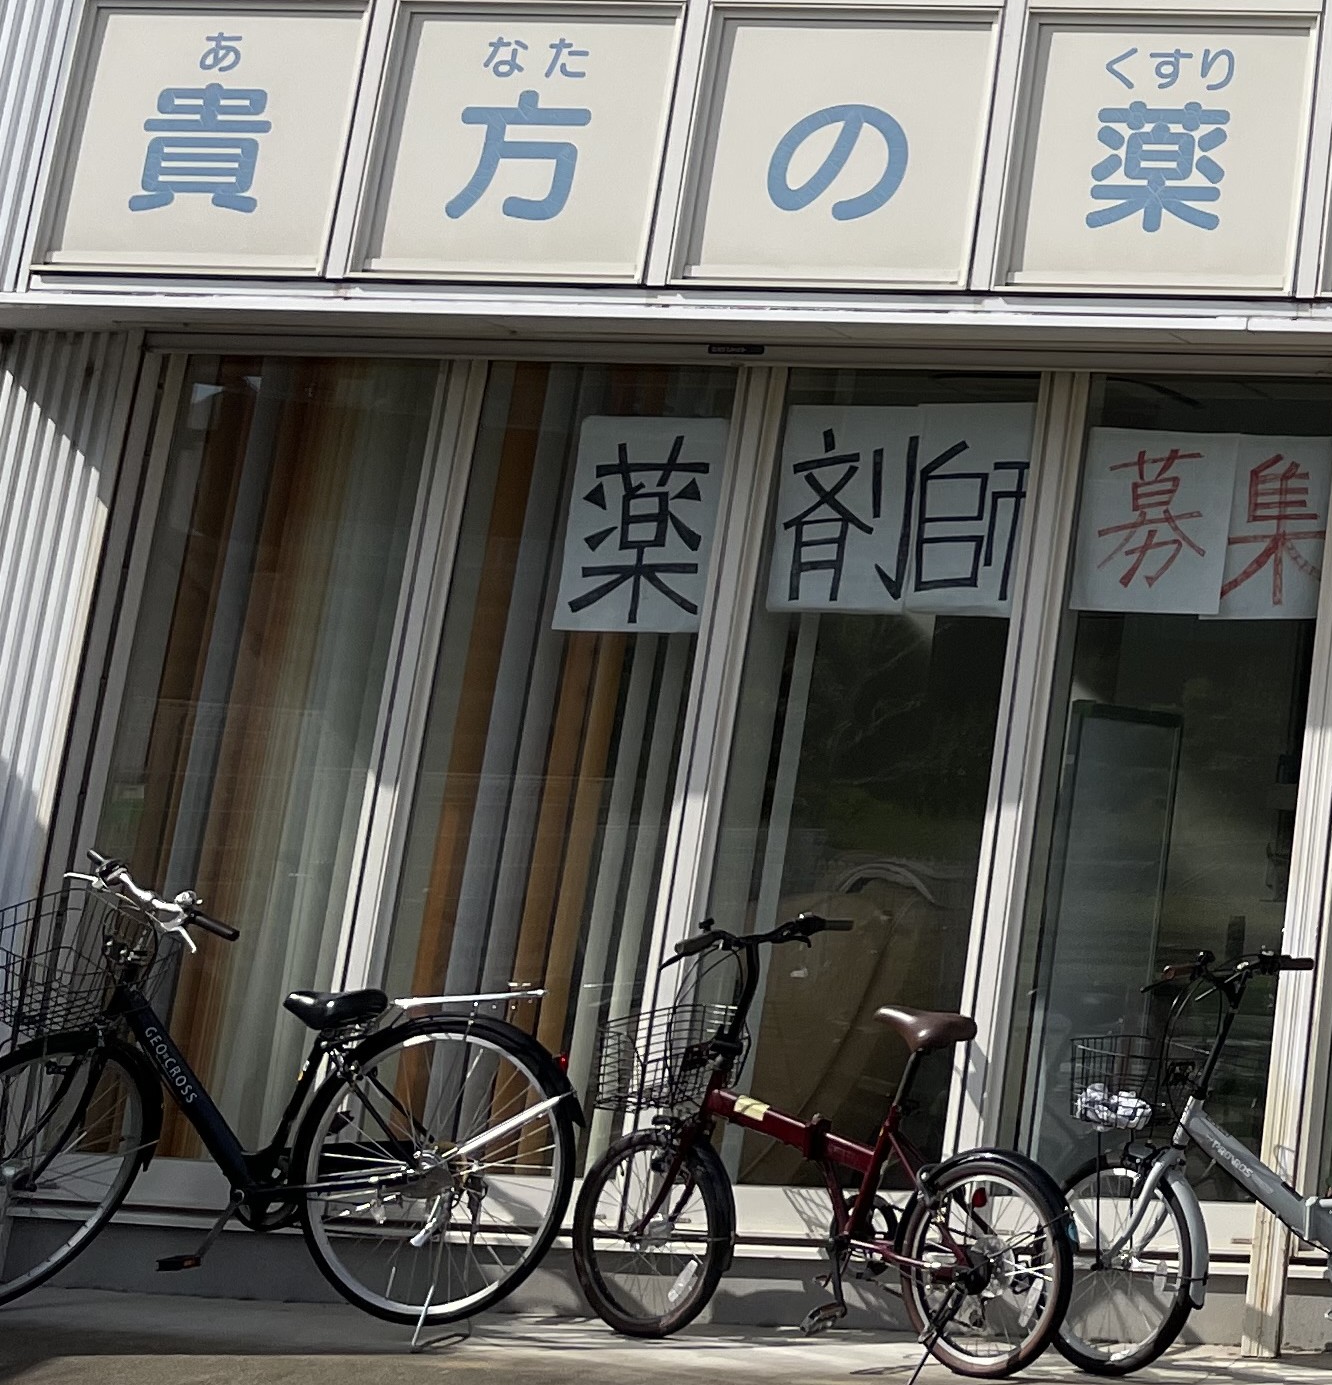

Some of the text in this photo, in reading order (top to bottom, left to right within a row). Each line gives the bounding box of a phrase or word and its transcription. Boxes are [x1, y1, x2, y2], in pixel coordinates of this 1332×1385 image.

[199, 31, 242, 73] あ
[481, 36, 590, 79] なた
[1104, 47, 1236, 91] くすり
